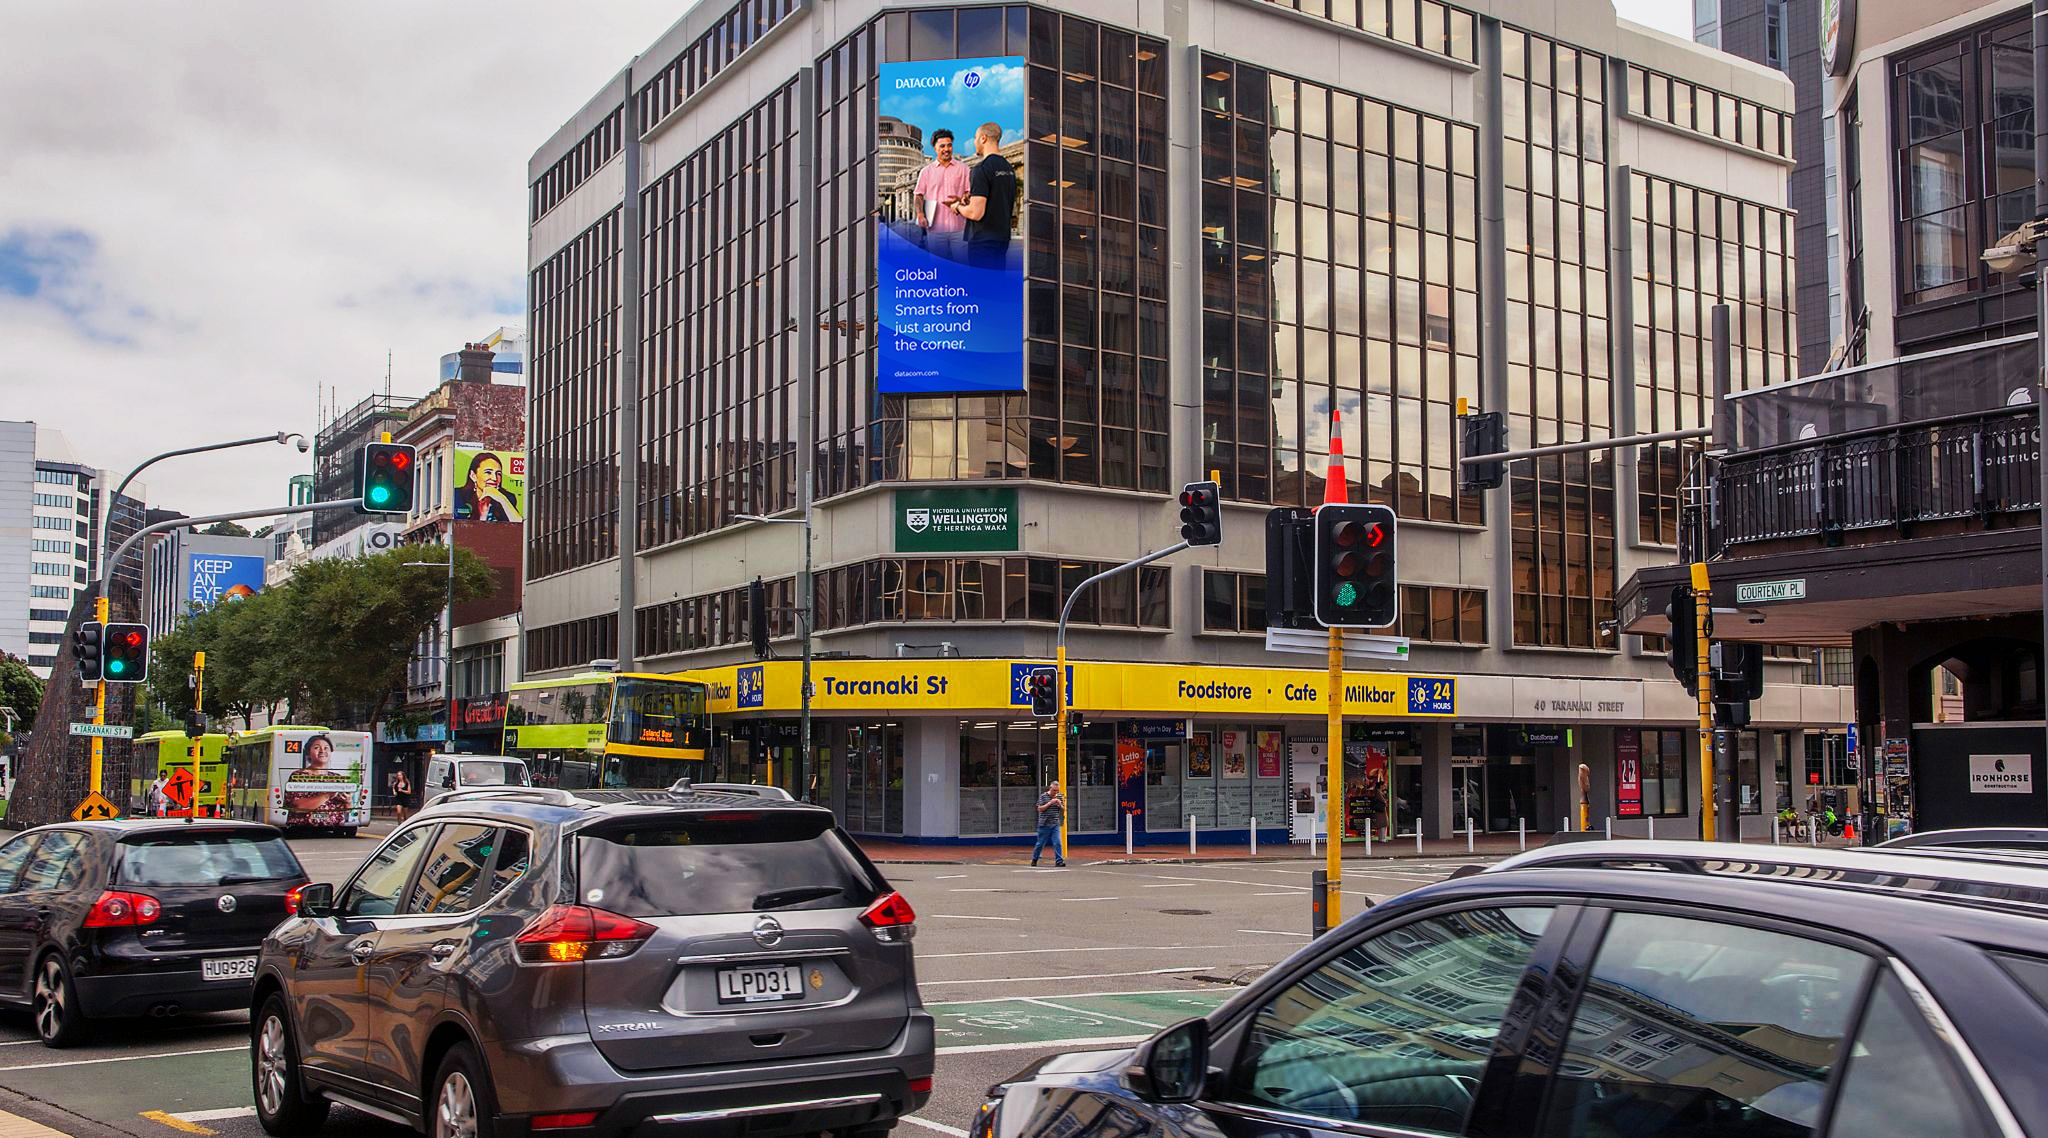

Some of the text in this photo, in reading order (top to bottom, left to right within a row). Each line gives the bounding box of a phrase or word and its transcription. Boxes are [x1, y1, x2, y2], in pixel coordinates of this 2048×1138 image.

[895, 76, 946, 89] DATACOM
[895, 267, 937, 281] Global
[895, 285, 968, 299] innovation.
[895, 302, 979, 317] Smarts from
[893, 319, 971, 337] just around
[895, 338, 966, 351] the corner.
[894, 370, 939, 378] datacom.com
[932, 513, 1008, 524] WELLINGTON
[194, 559, 233, 573] KEEP
[193, 572, 216, 587] AN
[193, 585, 222, 600] EYE
[1741, 582, 1801, 600] COURTENAY PL
[752, 670, 762, 691] 24
[823, 674, 949, 696] Taranaki St
[752, 693, 763, 702] HOURS
[1178, 680, 1396, 703] Foodstore Cafe Milkbar
[1433, 682, 1451, 700] 24
[1432, 702, 1451, 710] HOURS
[1534, 700, 1625, 712] 40 TARANAKI STREET
[80, 725, 122, 736] TARANAKI ST
[643, 729, 661, 737] Island
[1162, 725, 1172, 733] Day
[1175, 722, 1184, 731] 24
[684, 732, 690, 744] 1
[286, 741, 300, 753] 24
[1121, 752, 1140, 762] Lotto
[1972, 774, 2029, 782] IRONHORSE
[205, 960, 254, 976] HUQ928
[728, 971, 791, 995] LPD31
[598, 1022, 663, 1033] X-TRAIL
